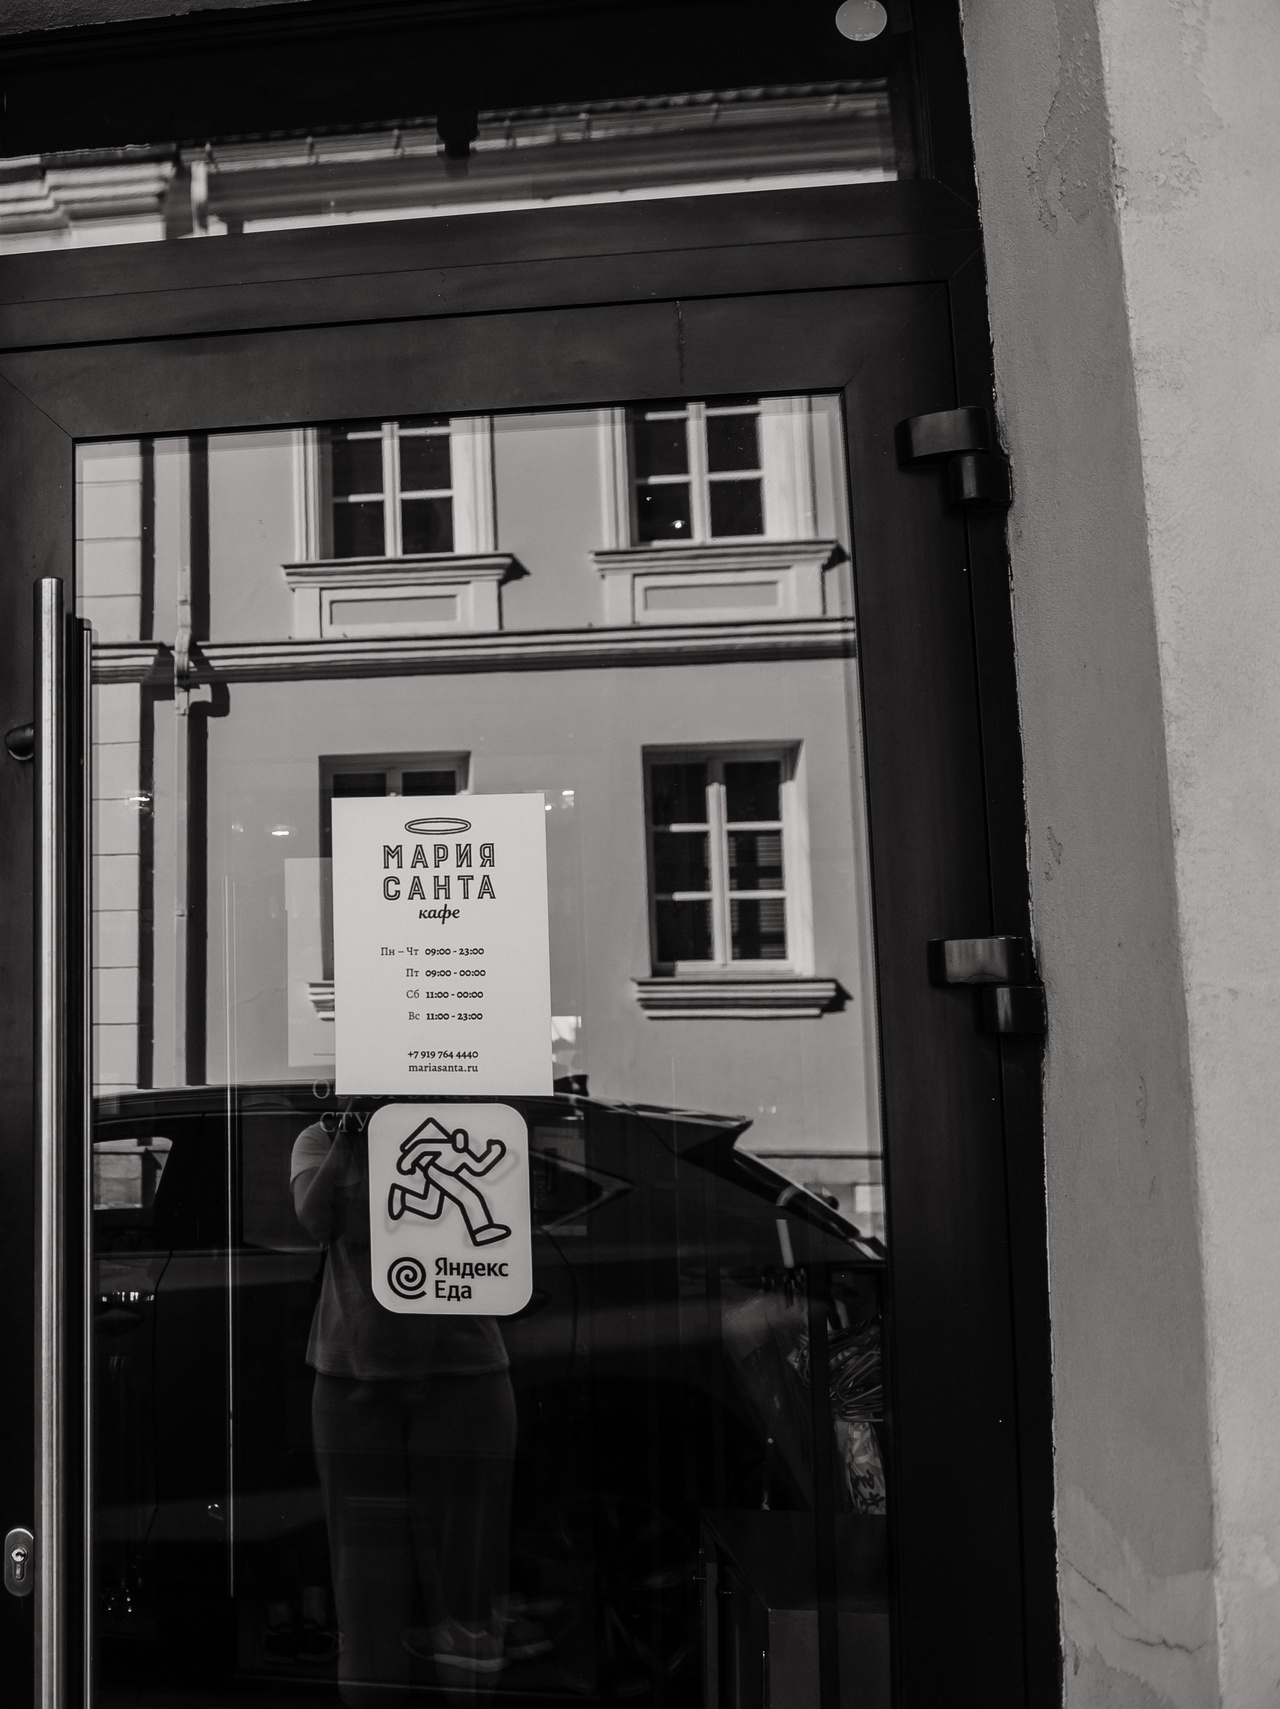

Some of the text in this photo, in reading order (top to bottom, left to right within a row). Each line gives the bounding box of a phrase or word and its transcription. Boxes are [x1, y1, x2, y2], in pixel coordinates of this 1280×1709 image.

[382, 843, 496, 869] МАРИЯ
[382, 875, 496, 901] САНТА
[418, 903, 461, 925] кафе
[380, 947, 396, 956] Пн
[406, 947, 420, 956] Чт
[424, 948, 452, 957] 09:00
[458, 947, 485, 957] 23:00
[406, 968, 420, 978] Пт
[425, 969, 452, 978] 09:00
[459, 969, 487, 977] 00:00
[406, 989, 420, 999] Сб
[425, 991, 450, 999] 11:00
[456, 991, 484, 999] 00:00
[408, 1011, 421, 1021] Вс
[426, 1013, 450, 1021] 11:00
[457, 1012, 484, 1021] 23:00
[407, 1049, 479, 1059] +7 919 764 4440
[408, 1062, 479, 1073] mariasanta.ru
[320, 1111, 371, 1132] СТУ
[434, 1257, 509, 1279] Яндекс
[434, 1280, 472, 1302] Еда
